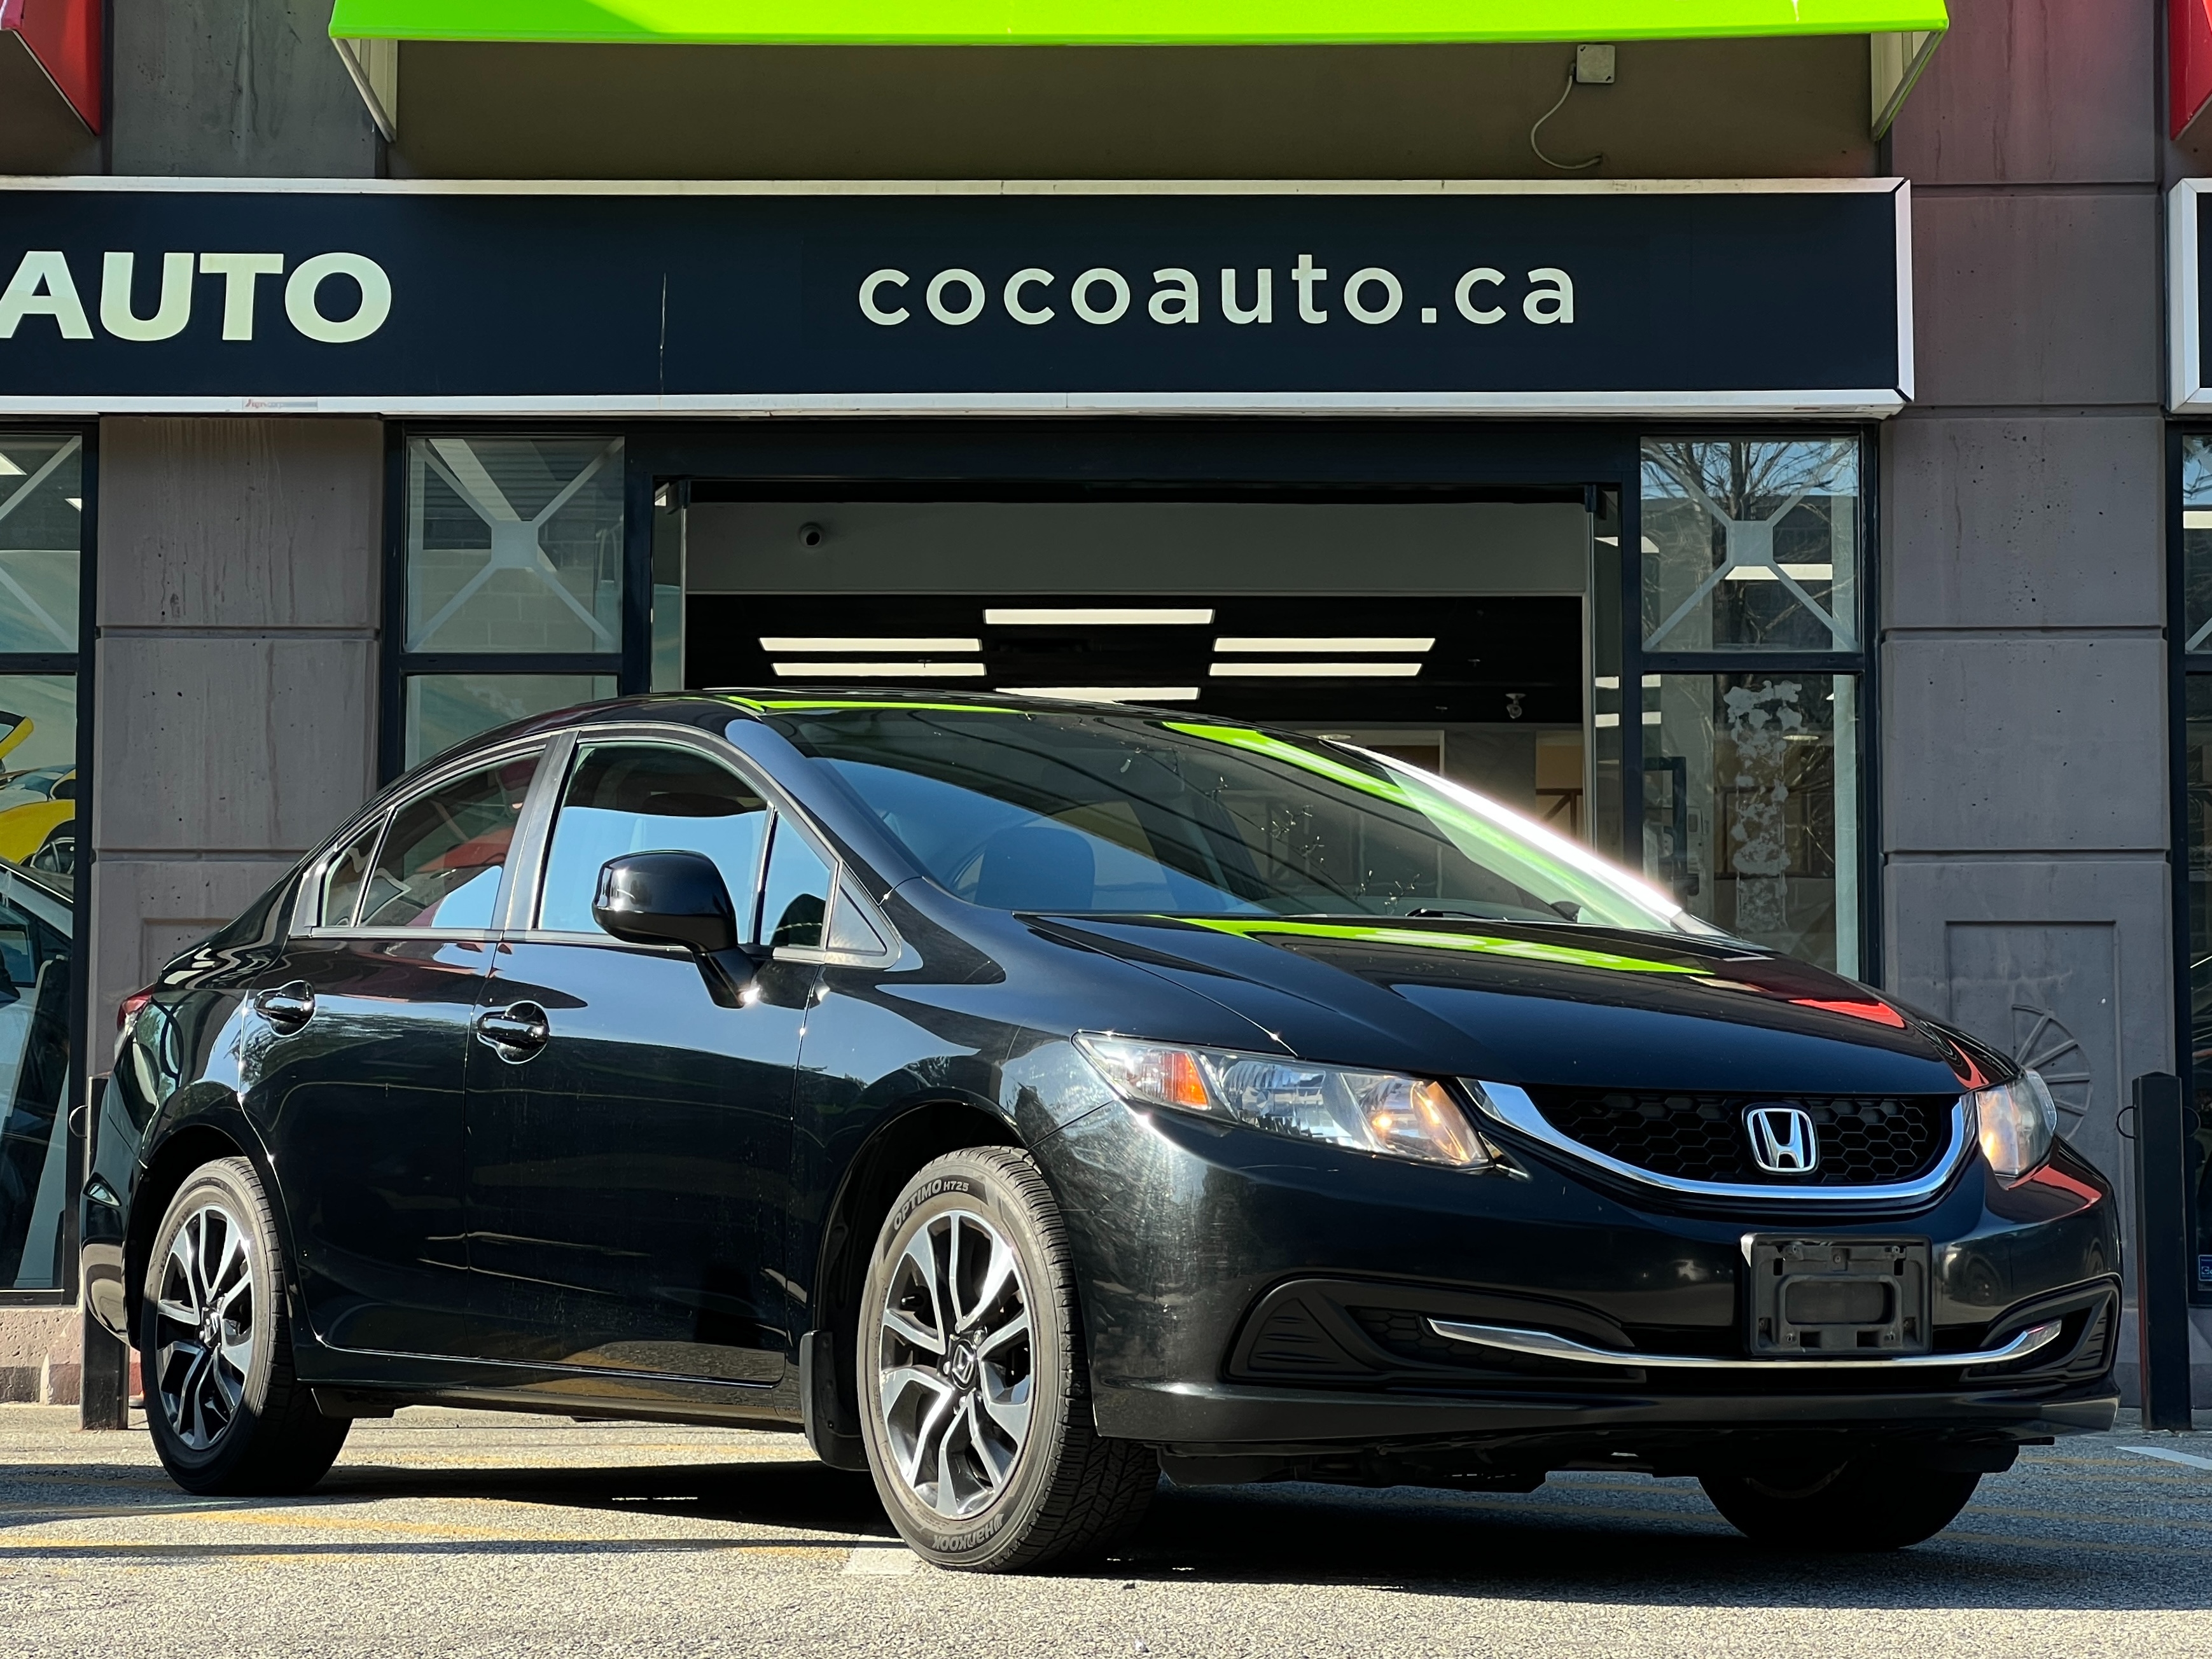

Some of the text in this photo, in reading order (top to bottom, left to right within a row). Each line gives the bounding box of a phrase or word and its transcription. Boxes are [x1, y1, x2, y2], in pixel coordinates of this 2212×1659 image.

[0, 251, 392, 344] AUTO
[859, 254, 1574, 326] cocoauto.ca
[894, 1179, 970, 1230] OPTIMO H725
